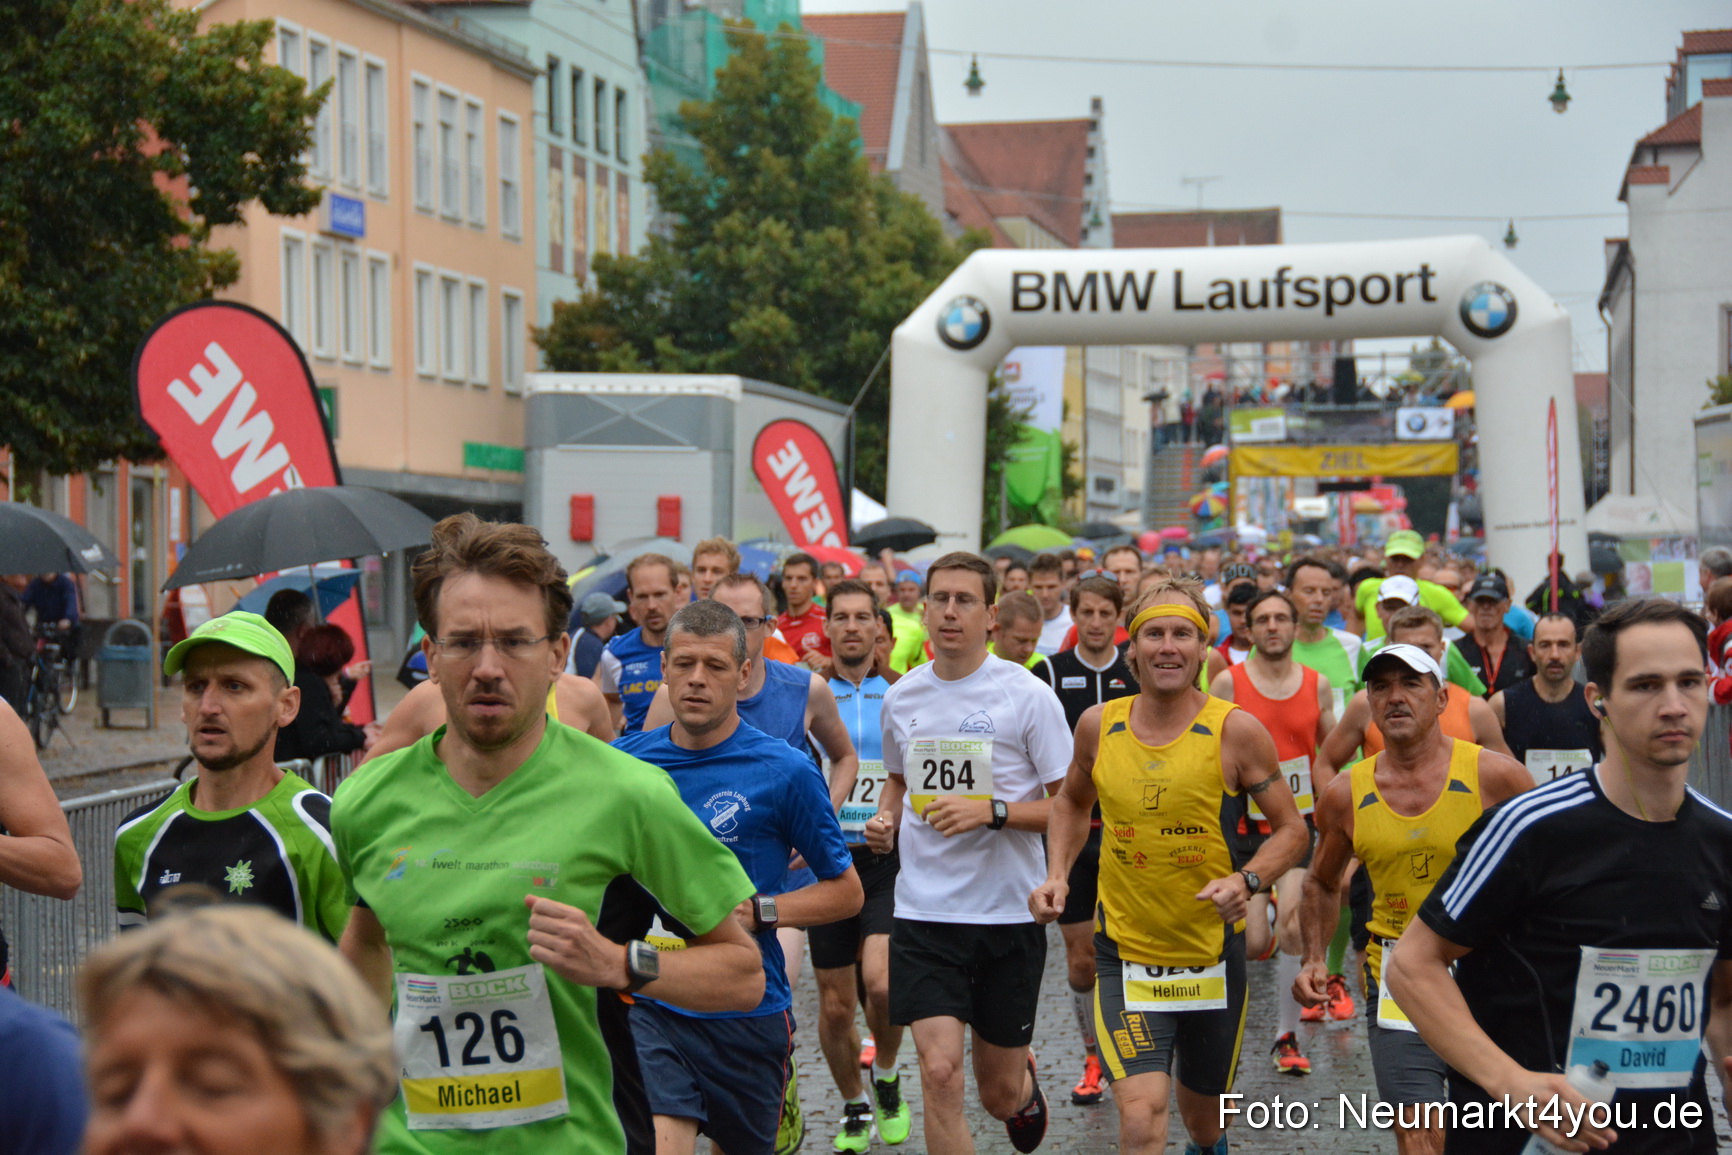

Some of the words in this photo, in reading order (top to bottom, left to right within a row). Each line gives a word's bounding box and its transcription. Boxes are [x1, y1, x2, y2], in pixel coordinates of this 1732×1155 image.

[1011, 270, 1157, 313] BMW
[1173, 263, 1438, 317] Laufsport
[1320, 451, 1369, 471] ZIEL
[940, 741, 984, 752] BOCK
[922, 758, 975, 791] 264
[1114, 826, 1135, 838] Seidl
[1161, 820, 1208, 836] RÖDL
[1168, 845, 1207, 858] PIZZERIA
[1177, 853, 1204, 865] ELIO
[432, 857, 462, 871] iwelt
[465, 861, 509, 871] marathon
[1386, 897, 1409, 910] Seidl
[1593, 963, 1640, 974] NeuerMarkt
[448, 974, 531, 1000] BOCK
[1153, 984, 1201, 998] Helmut
[1591, 982, 1696, 1034] 2460
[1126, 1013, 1150, 1047] Run!
[420, 1009, 526, 1068] 126
[1621, 1047, 1667, 1067] David
[402, 1067, 409, 1077] A
[438, 1080, 522, 1108] Michael
